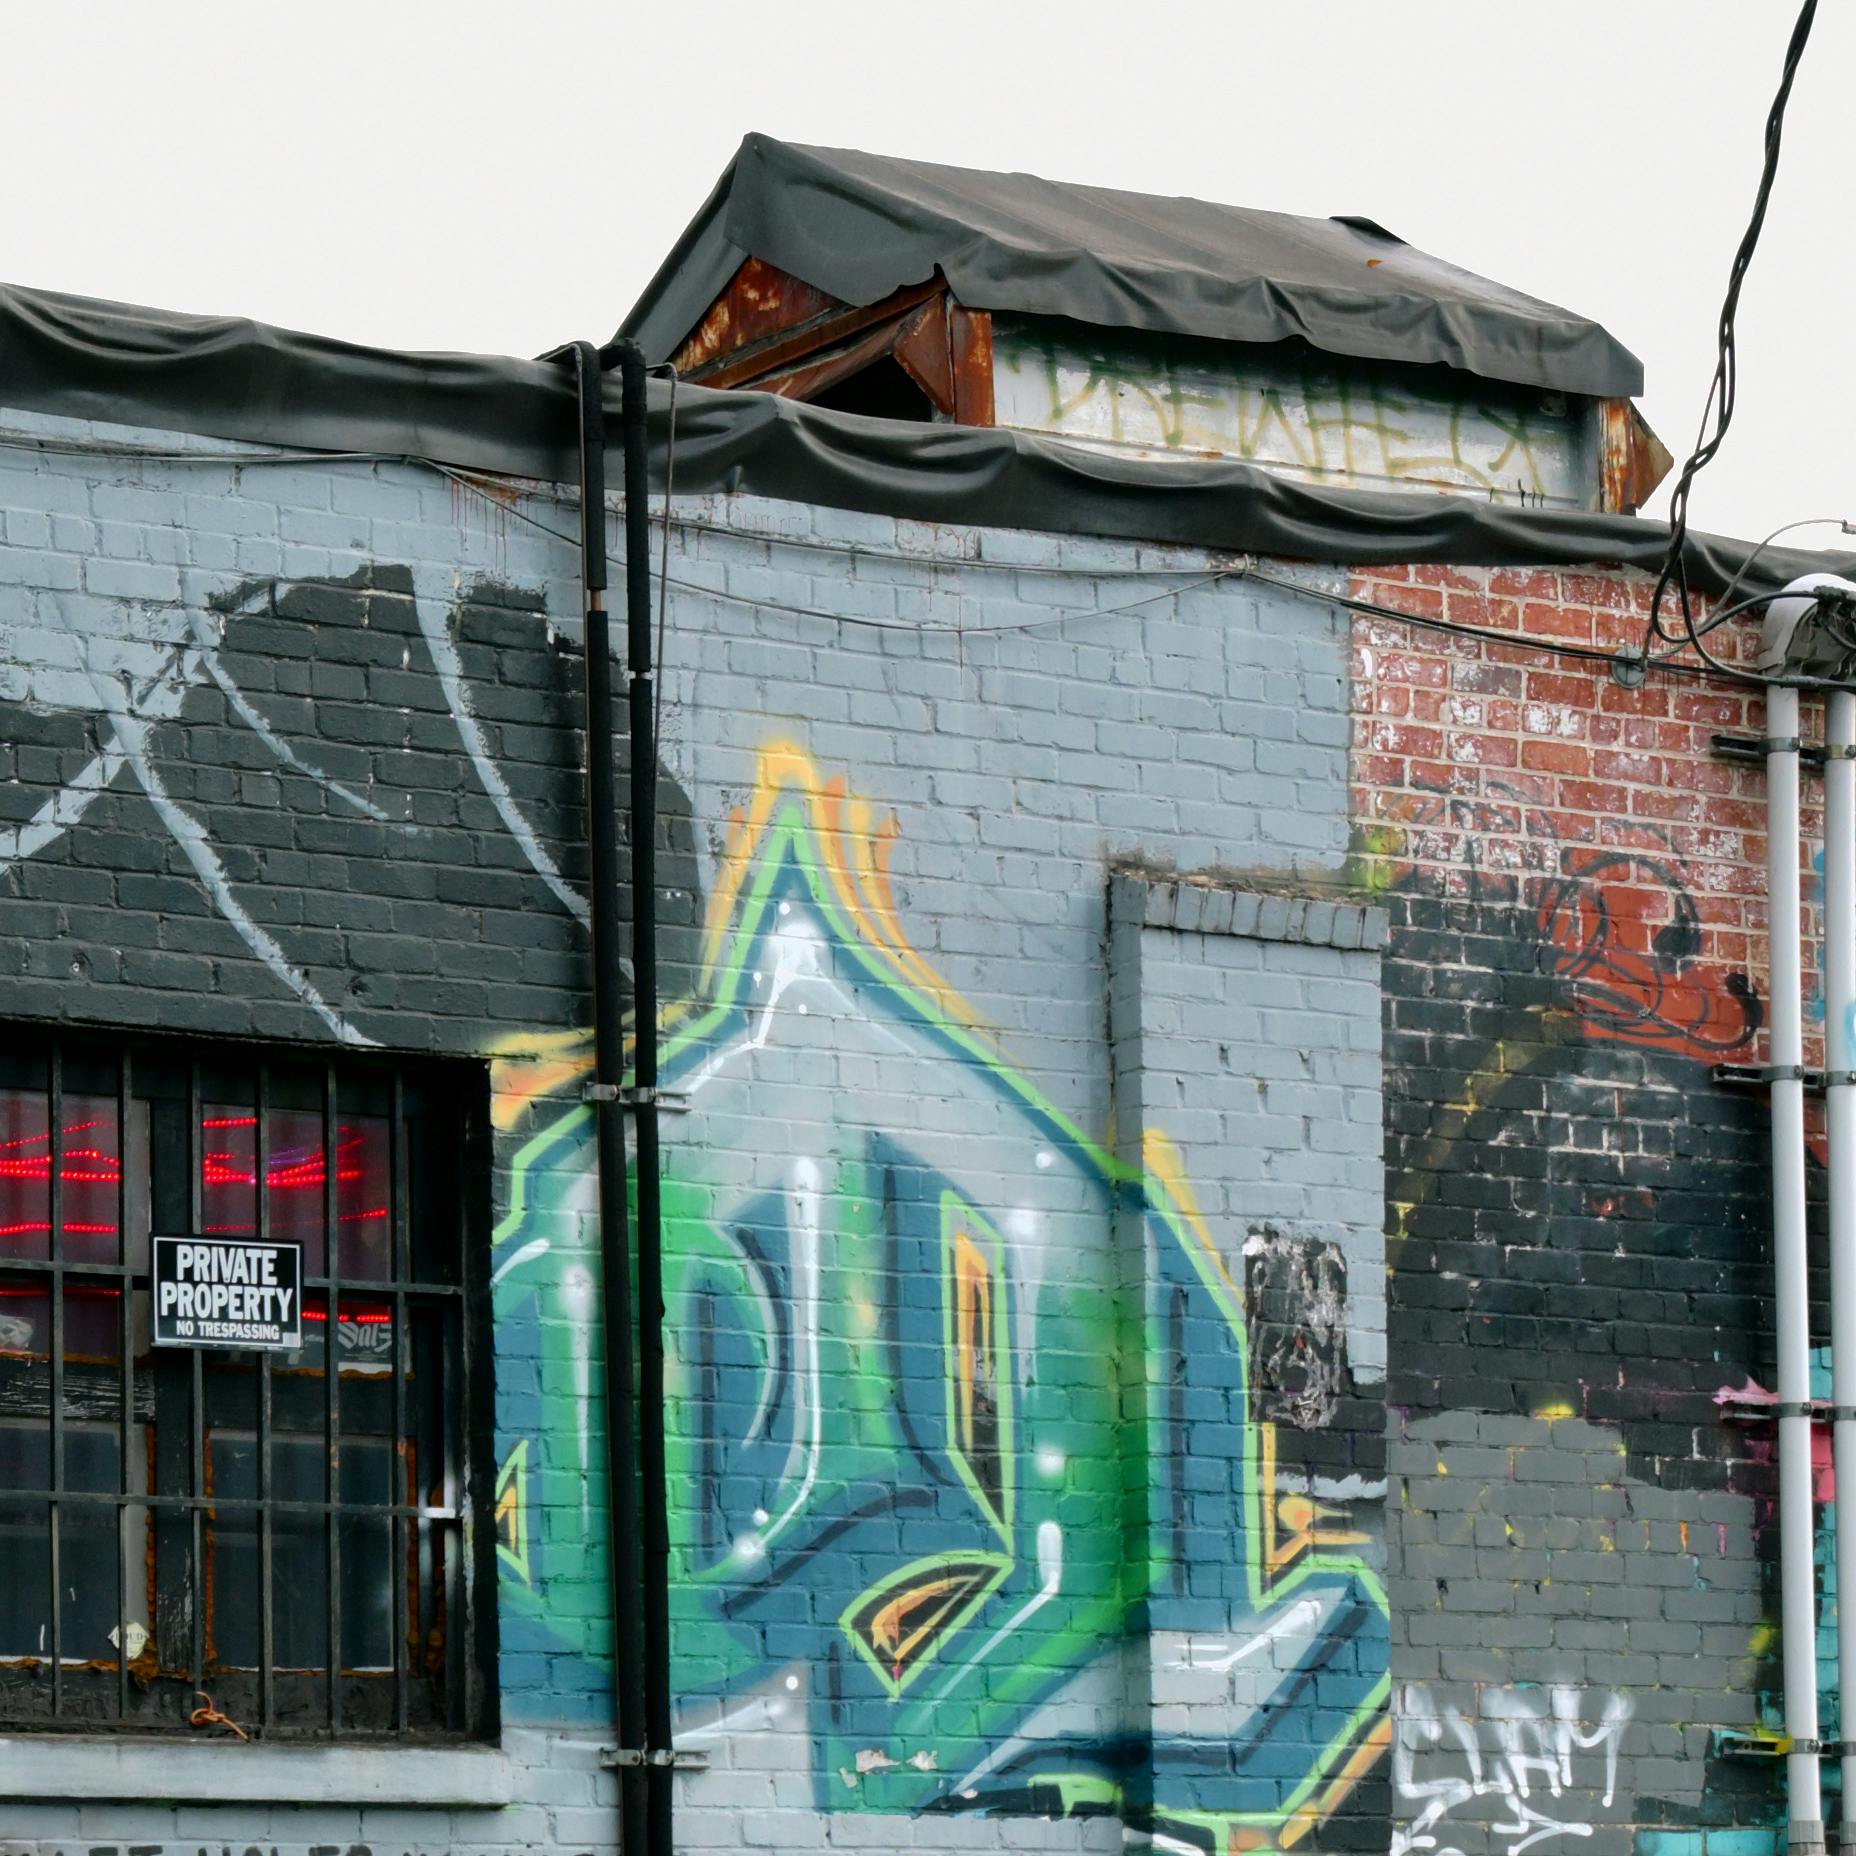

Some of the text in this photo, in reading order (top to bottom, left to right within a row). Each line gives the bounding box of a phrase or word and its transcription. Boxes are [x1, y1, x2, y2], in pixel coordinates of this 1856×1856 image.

[176, 1244, 277, 1286] PRIVATE
[160, 1281, 293, 1322] PROPERTY
[176, 1320, 280, 1340] NO TRESPASSING
